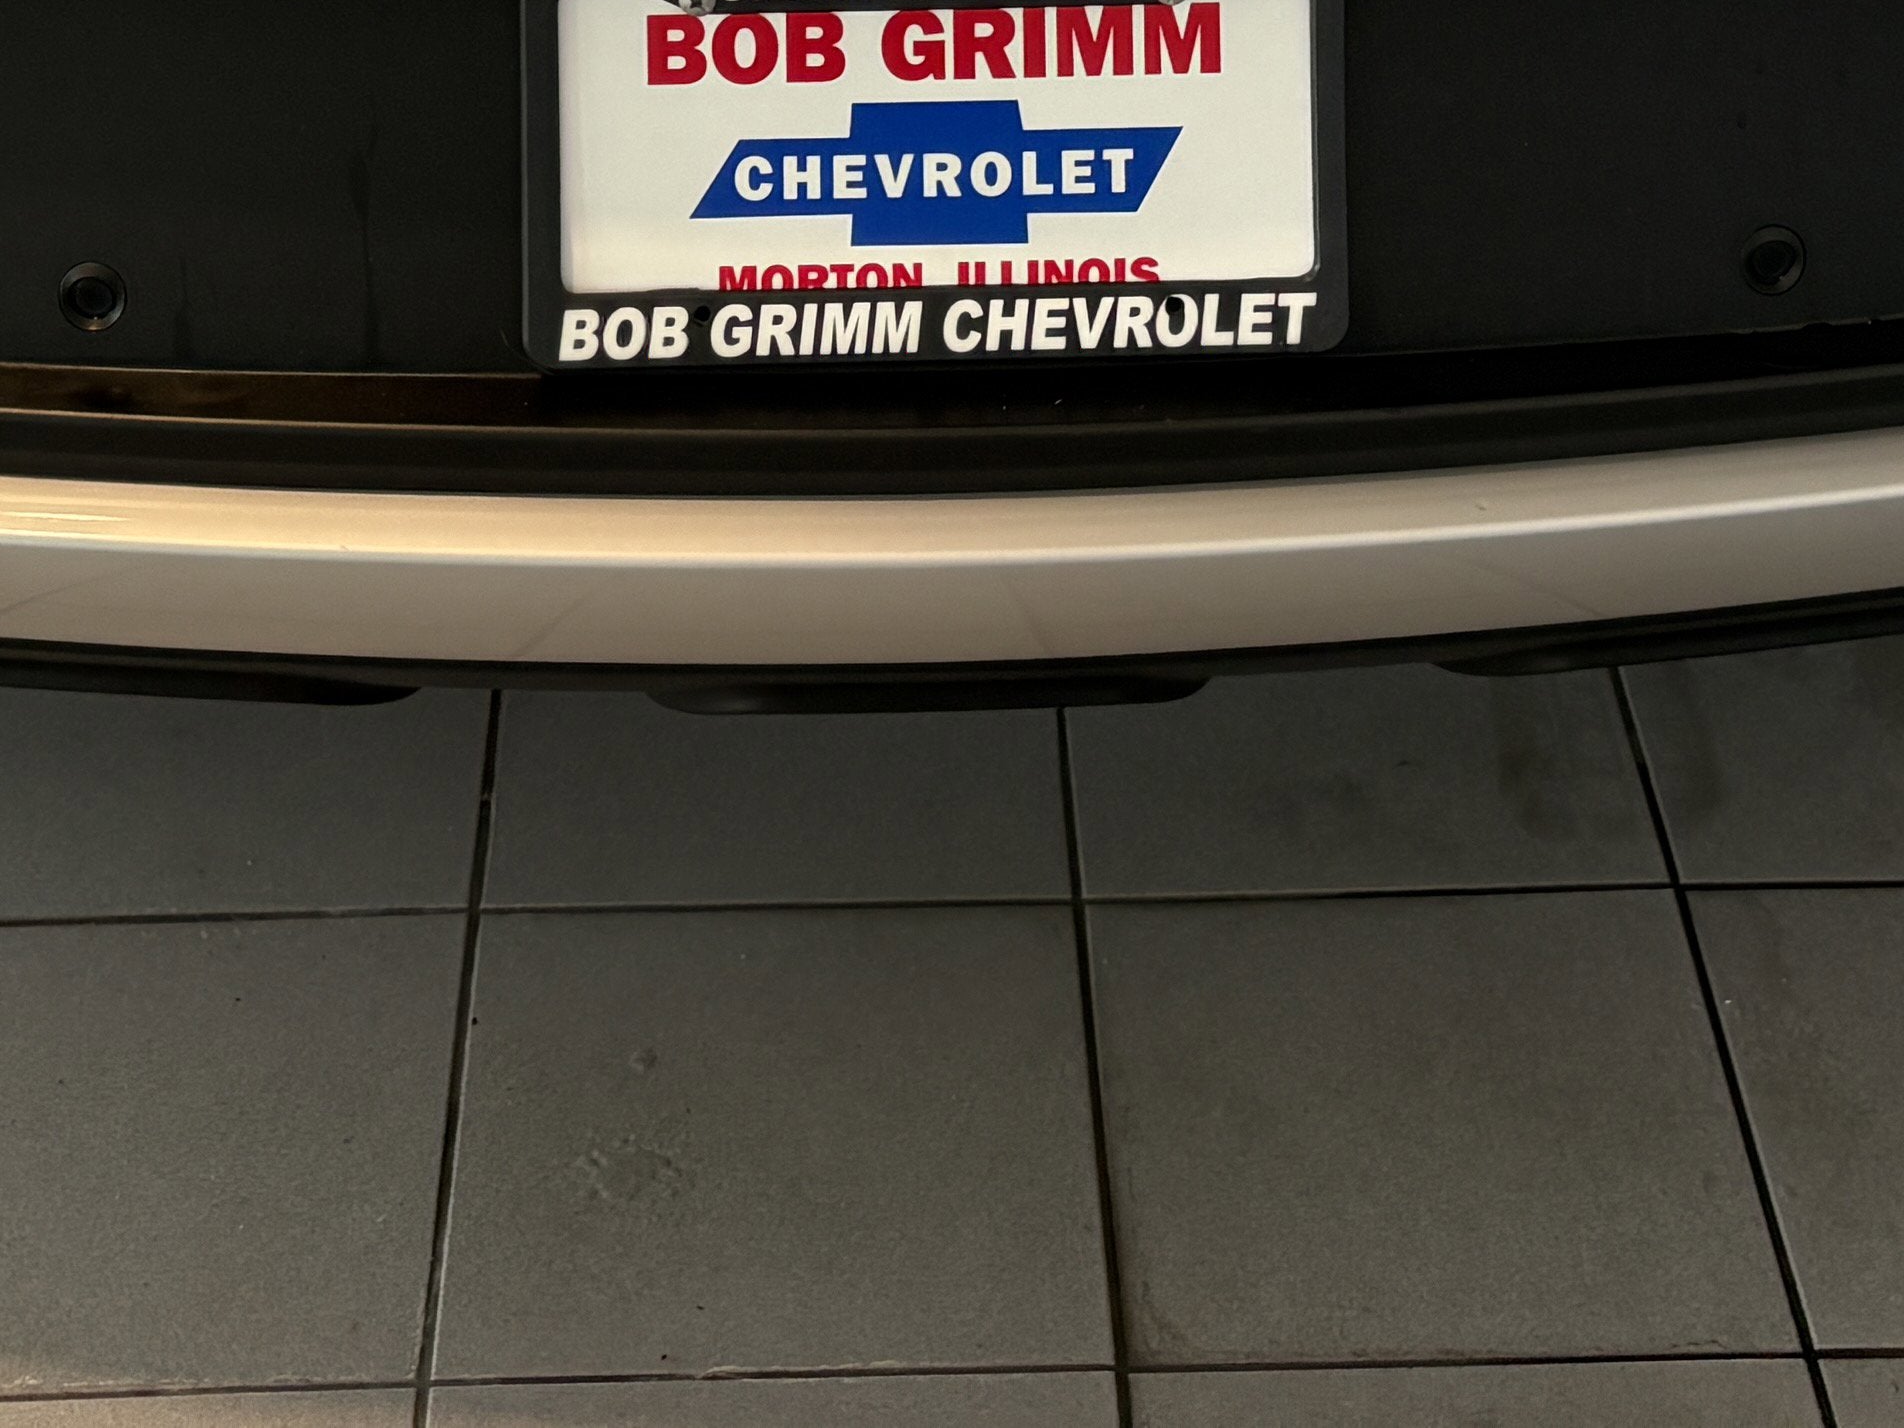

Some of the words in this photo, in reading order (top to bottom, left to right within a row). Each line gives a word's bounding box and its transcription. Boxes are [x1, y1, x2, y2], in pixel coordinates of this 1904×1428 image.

[647, 11, 846, 86] BOB
[881, 2, 1222, 82] GRIMM
[734, 148, 1134, 202] CHEVROLET
[559, 305, 689, 362] BOB
[710, 300, 923, 358] GRIMM
[943, 292, 1317, 353] CHEVROLET
